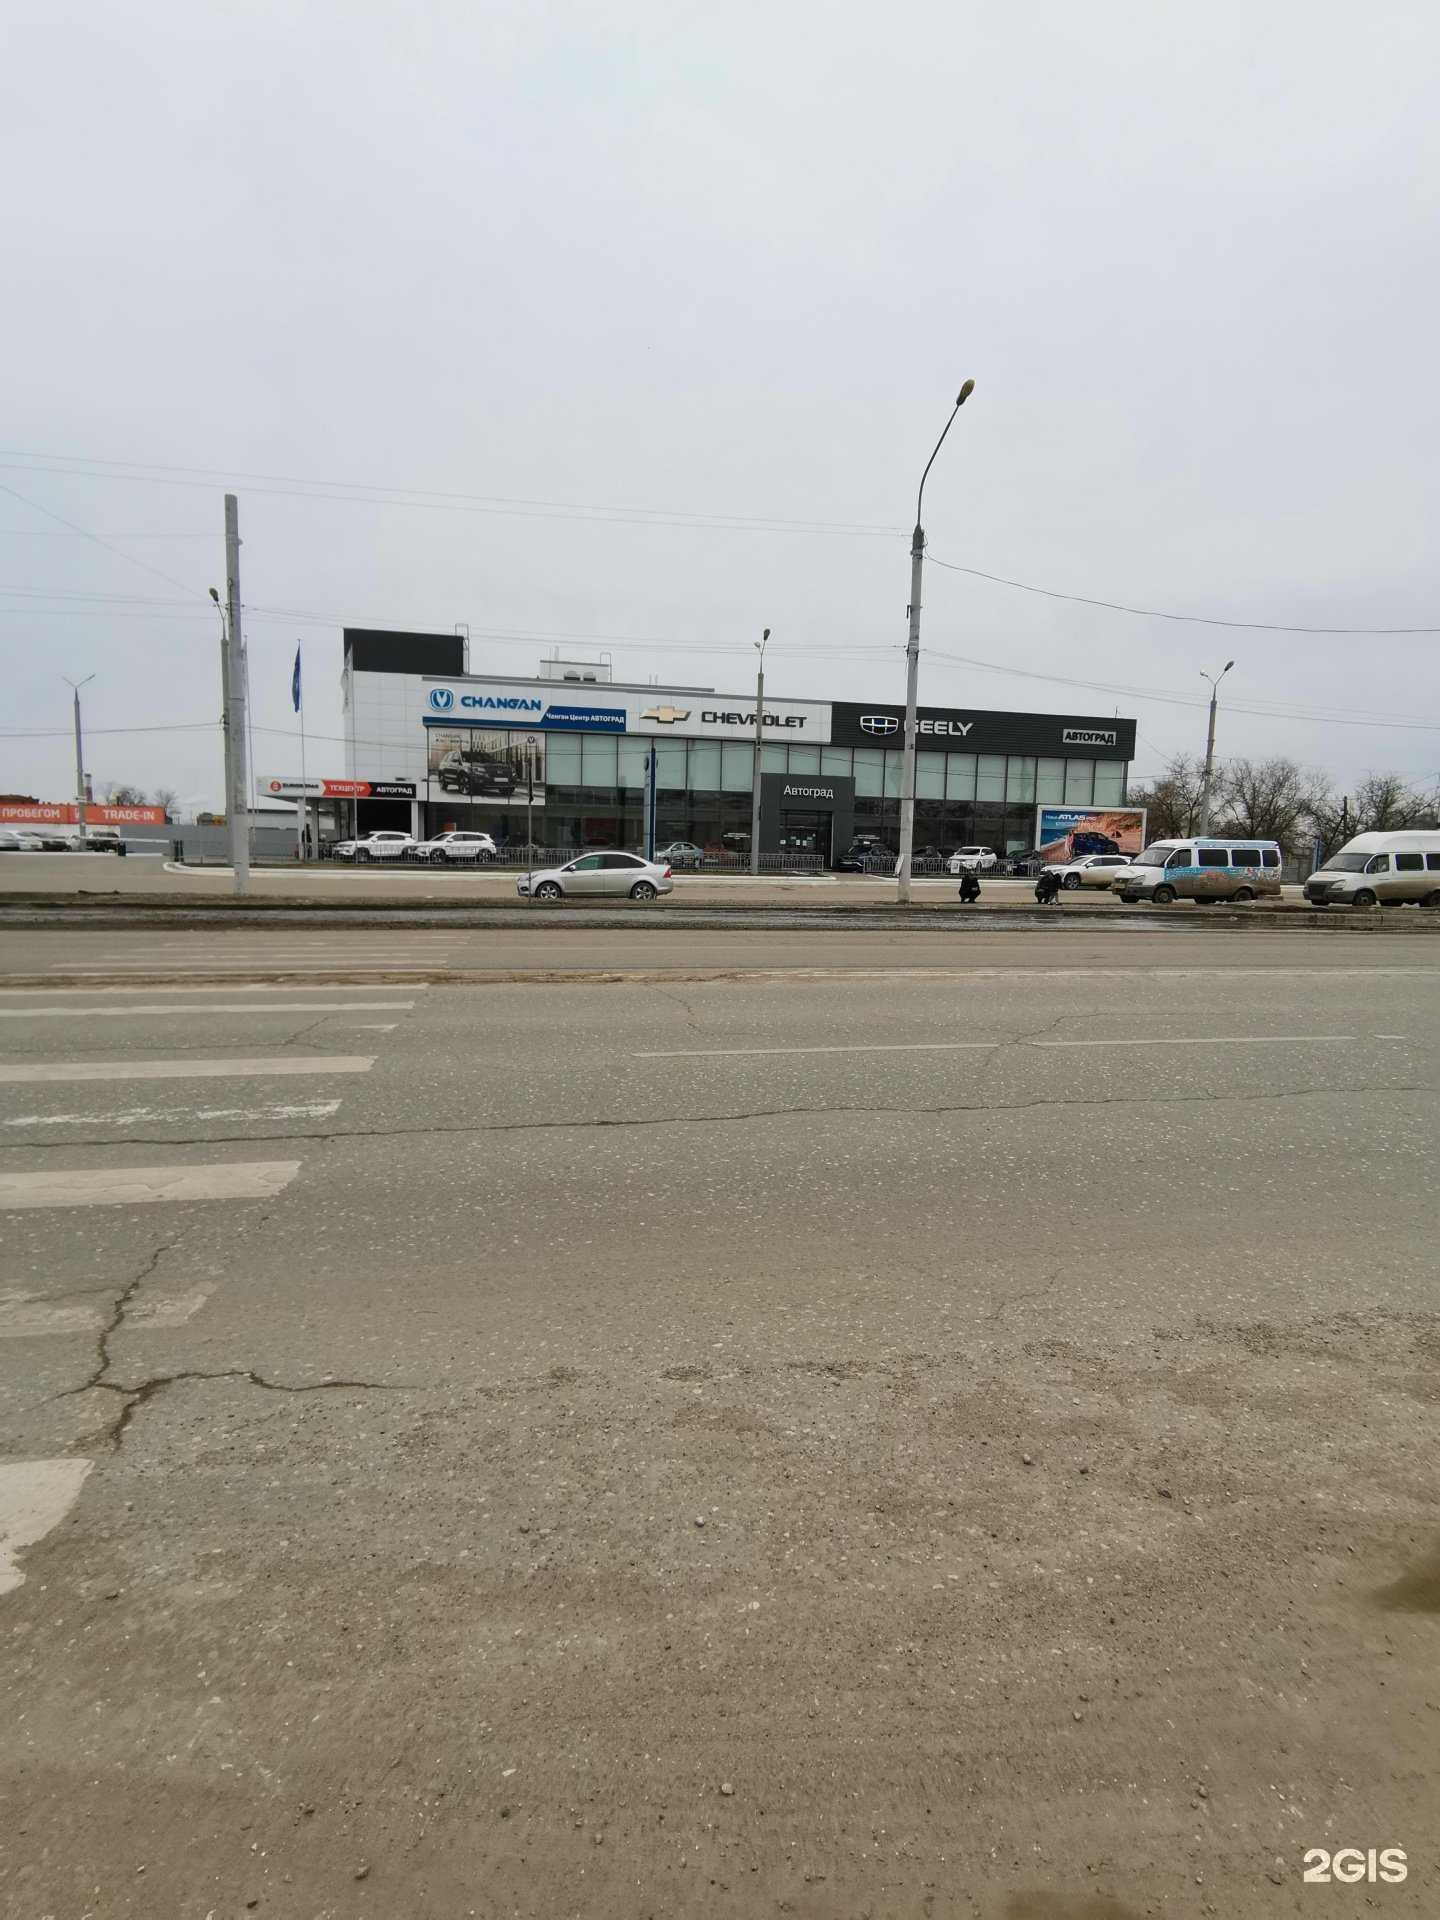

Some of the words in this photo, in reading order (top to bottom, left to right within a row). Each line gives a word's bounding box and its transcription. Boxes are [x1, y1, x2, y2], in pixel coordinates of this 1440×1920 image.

[461, 695, 542, 711] CHANGAN
[570, 713, 590, 722] Центр
[590, 714, 625, 724] АВТОГРАД
[1064, 731, 1115, 745] АВТОГРАД
[376, 786, 413, 795] АВТОГРАД
[783, 784, 834, 799] Автоград
[2, 807, 61, 819] ПРОБЕГОМ
[103, 808, 156, 821] TRADE-IN
